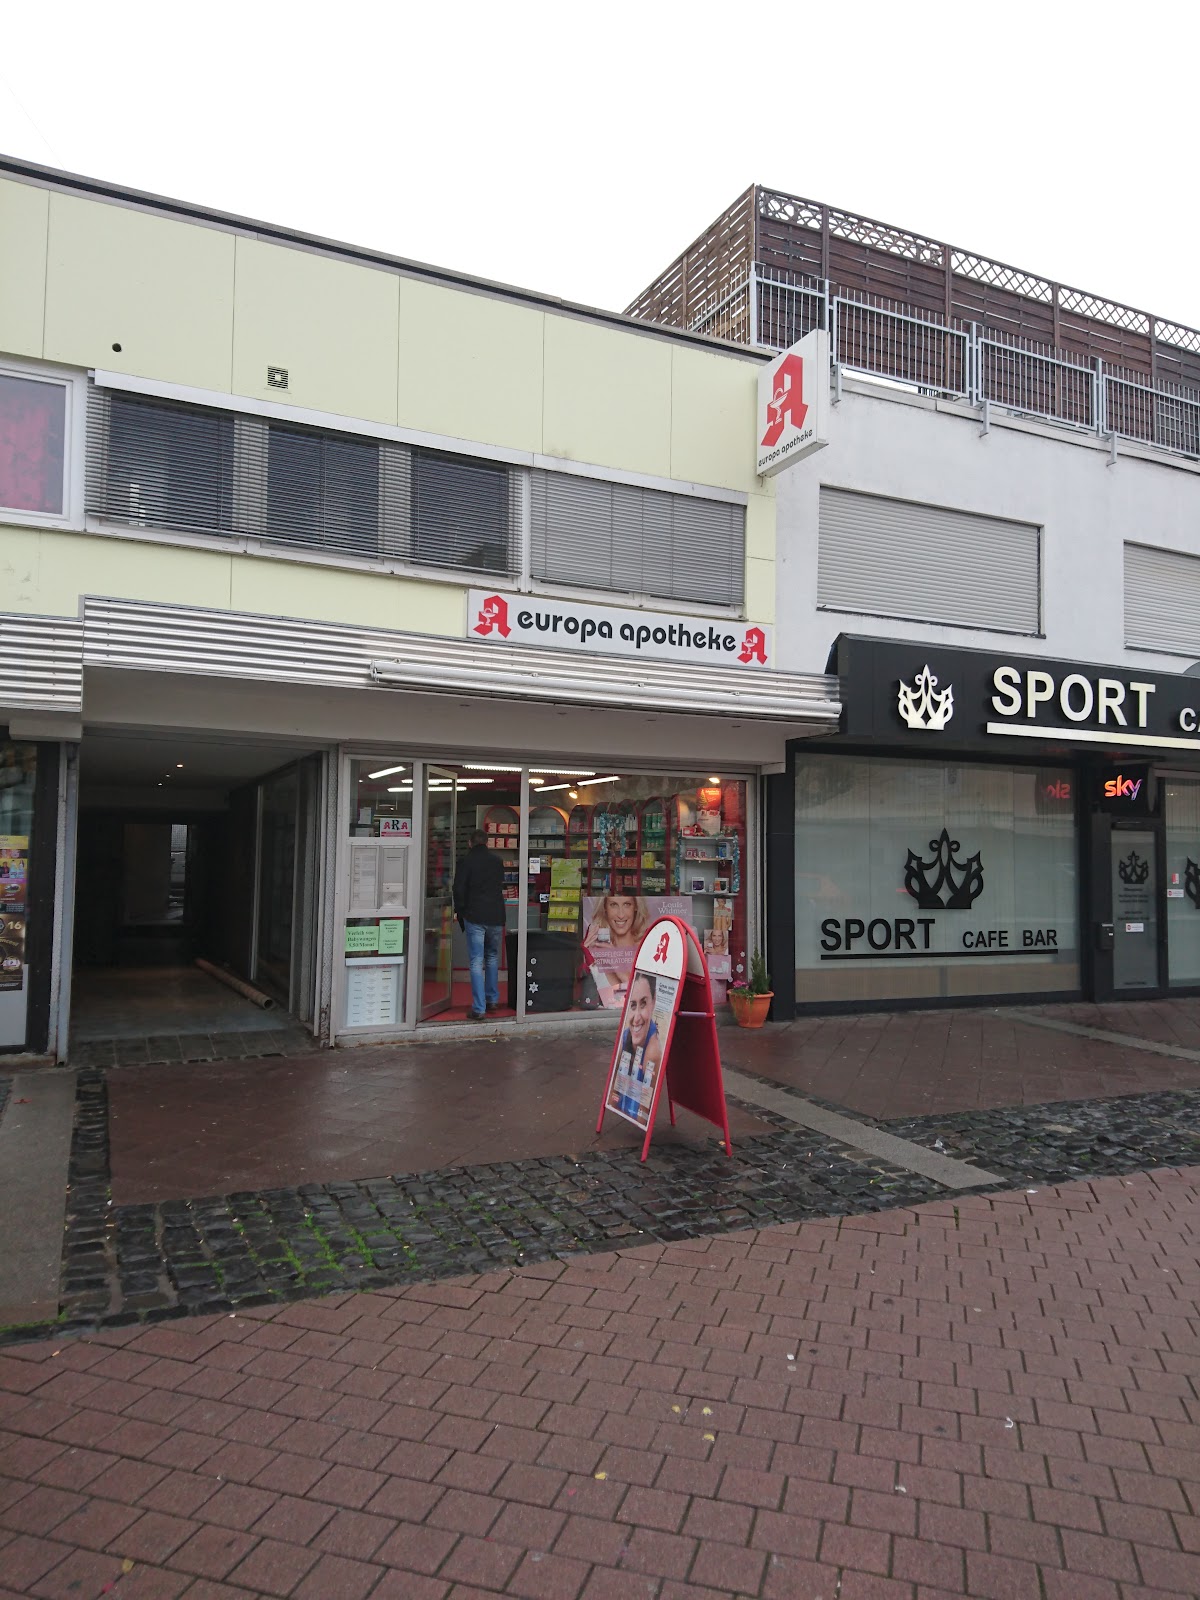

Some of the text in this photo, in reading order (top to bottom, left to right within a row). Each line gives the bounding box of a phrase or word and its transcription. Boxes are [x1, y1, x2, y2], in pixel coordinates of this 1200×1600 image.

[758, 429, 813, 467] europa apotheke
[517, 610, 613, 643] europa
[619, 622, 737, 651] apotheke
[991, 665, 1156, 728] SPORT
[1104, 775, 1143, 800] sky
[7, 921, 22, 930] 16
[820, 917, 1058, 951] SPORT CAFE BAR
